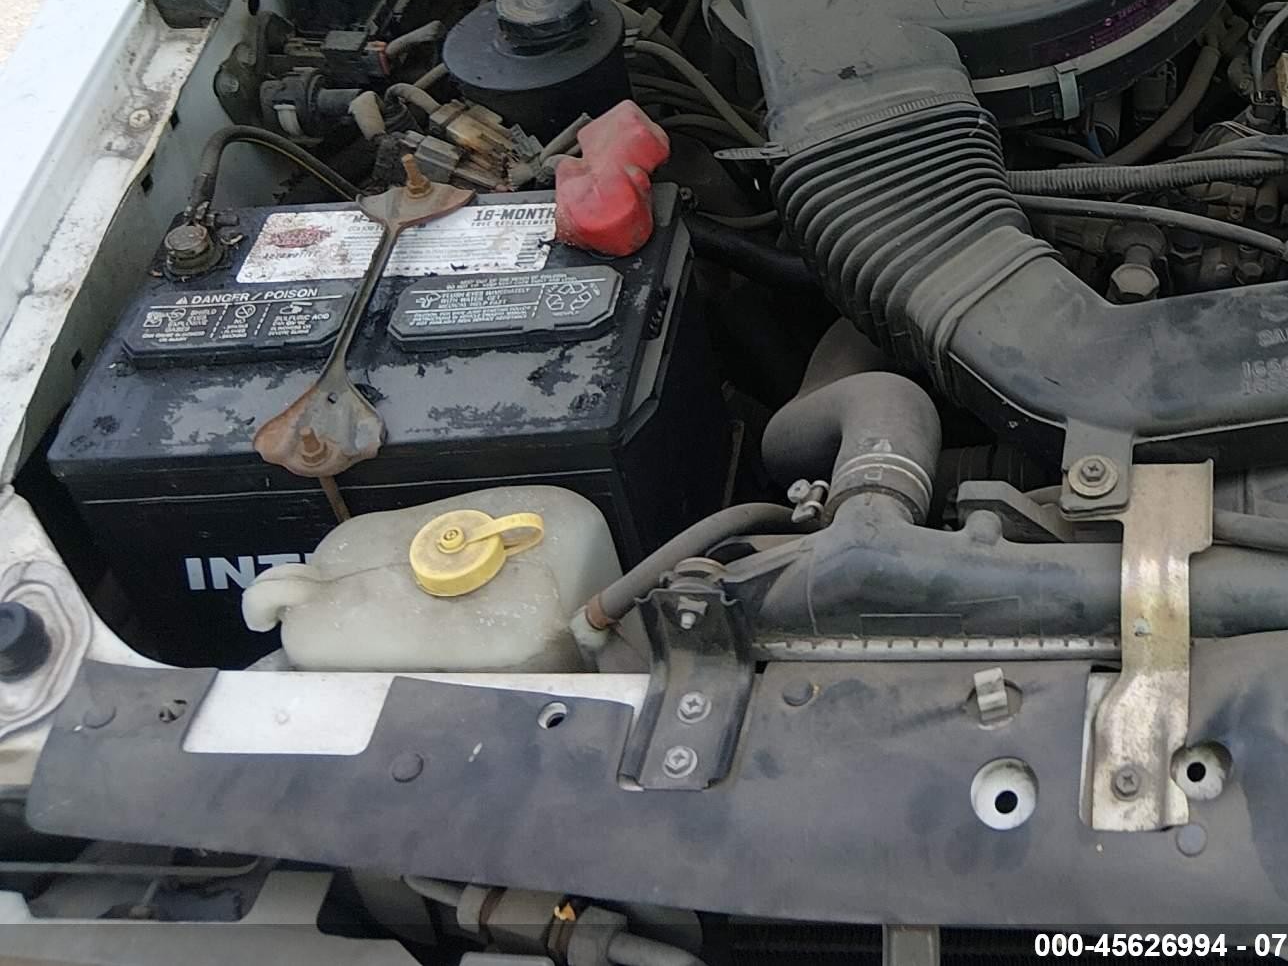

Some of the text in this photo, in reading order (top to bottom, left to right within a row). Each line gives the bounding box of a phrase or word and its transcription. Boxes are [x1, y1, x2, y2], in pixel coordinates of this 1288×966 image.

[472, 207, 557, 222] 18-MONTH
[190, 293, 250, 305] DANGER
[263, 287, 319, 300] POISON
[184, 552, 313, 591] INT
